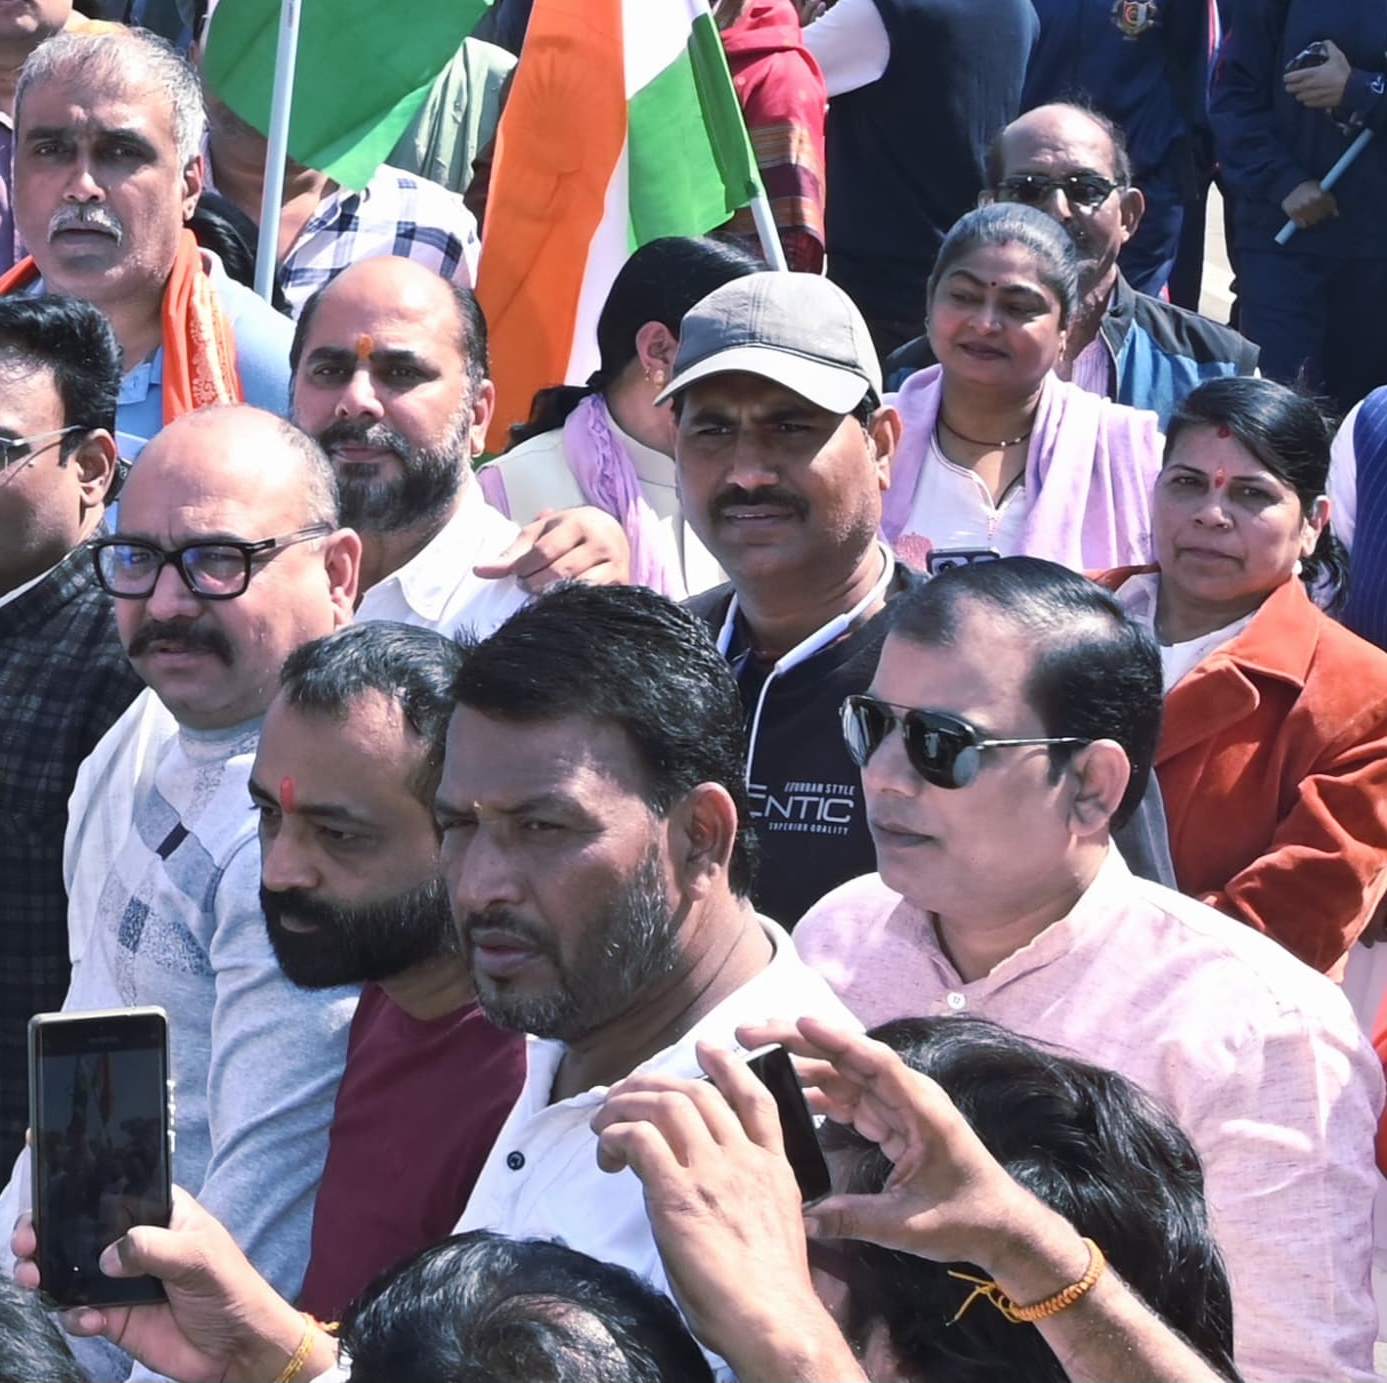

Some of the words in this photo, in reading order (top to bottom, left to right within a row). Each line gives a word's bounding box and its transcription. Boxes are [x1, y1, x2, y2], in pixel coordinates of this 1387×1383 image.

[826, 783, 855, 796] STYLE
[746, 782, 855, 824] ENTIC
[768, 822, 808, 832] SUPERIOR
[810, 823, 849, 835] QUALITY
